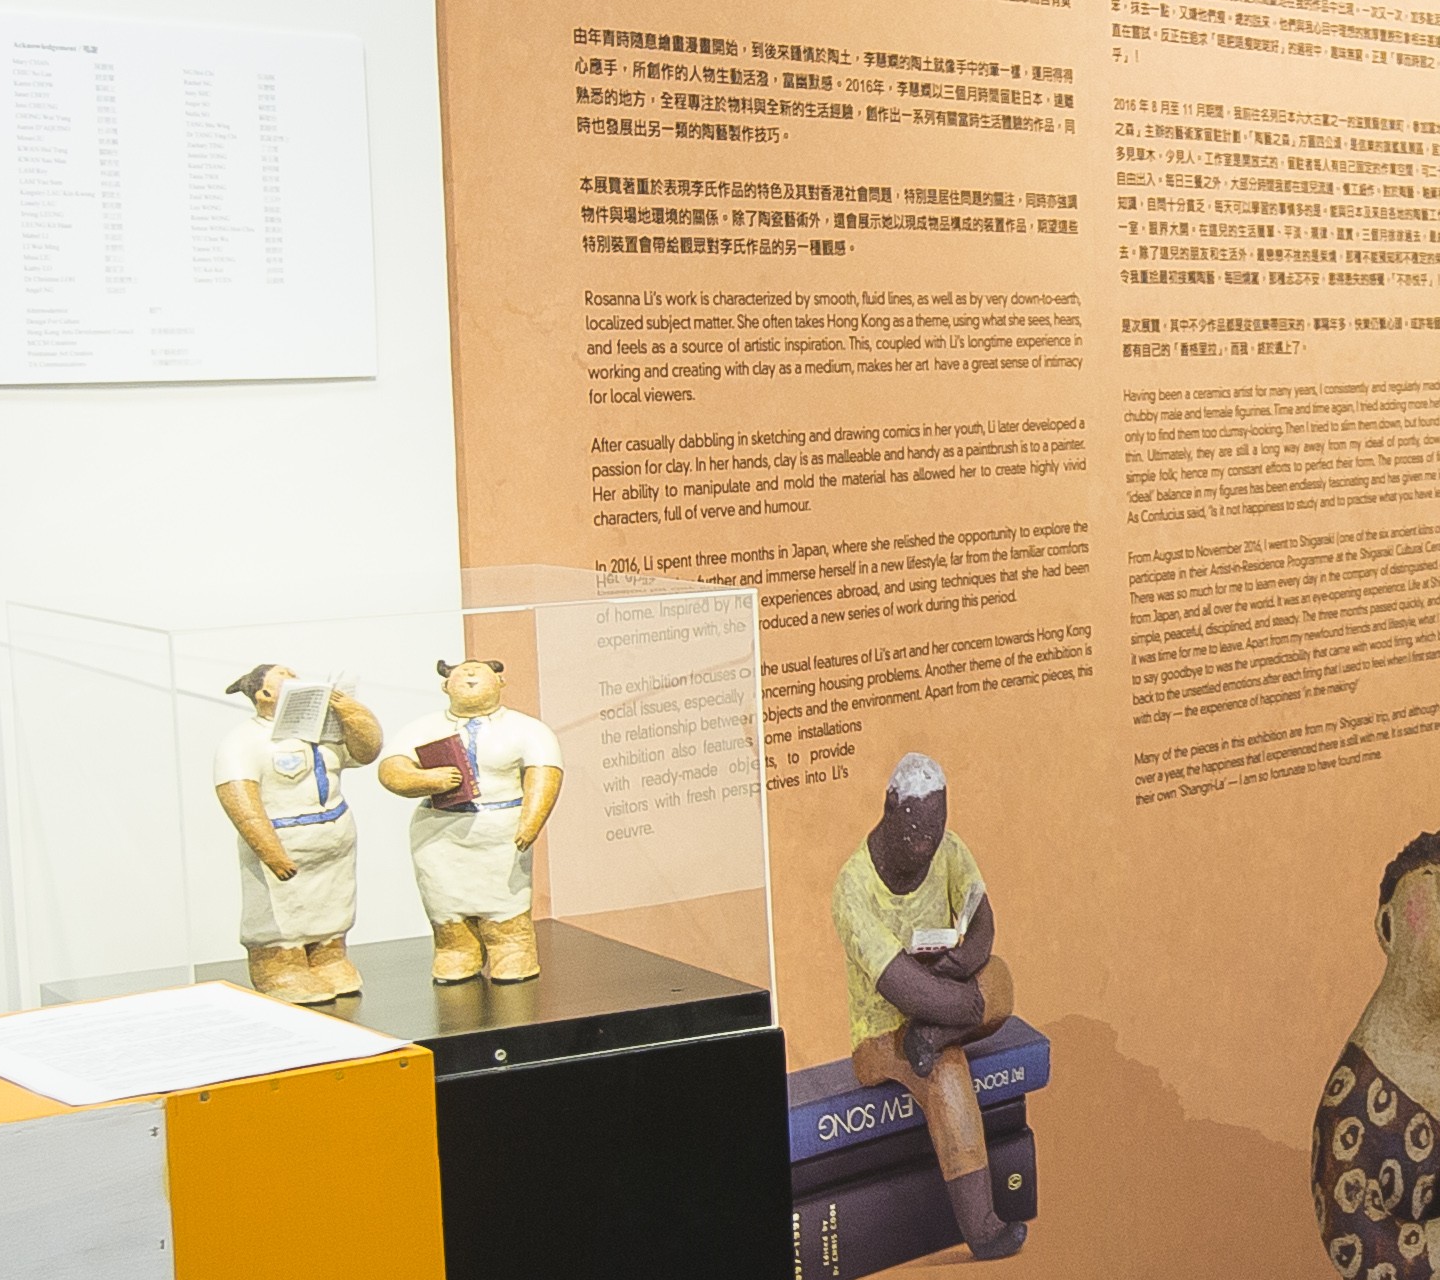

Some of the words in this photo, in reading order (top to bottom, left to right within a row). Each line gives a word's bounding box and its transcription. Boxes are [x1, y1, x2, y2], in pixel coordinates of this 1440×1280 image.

[585, 290, 640, 306] Rosanna
[644, 291, 662, 305] Li's
[666, 291, 697, 305] work
[701, 291, 709, 305] is
[713, 291, 792, 305] characterized
[795, 292, 810, 308] by
[814, 292, 859, 307] smooth,
[862, 291, 885, 305] fluid
[888, 292, 914, 306] lines,
[917, 295, 929, 305] as
[932, 292, 953, 305] well
[956, 295, 966, 305] as
[970, 292, 983, 307] by
[986, 295, 1007, 307] very
[587, 340, 612, 355] and
[617, 339, 647, 354] feels
[652, 343, 665, 354] as
[670, 343, 677, 353] a
[682, 342, 723, 353] source
[728, 338, 739, 352] of
[744, 338, 780, 352] artistic
[785, 337, 845, 354] inspiration.
[849, 336, 871, 351] This,
[876, 336, 921, 352] coupled
[925, 338, 946, 348] with
[950, 336, 964, 348] Li's
[1016, 337, 1071, 349] experience
[589, 389, 607, 404] for
[611, 388, 641, 403] local
[644, 388, 695, 402] viewers.
[591, 437, 622, 453] After
[626, 435, 675, 453] casually
[679, 433, 734, 450] dabbling
[738, 432, 748, 445] in
[752, 430, 805, 446] sketching
[809, 428, 831, 442] and
[834, 427, 879, 443] drawing
[883, 424, 920, 438] comics
[923, 424, 932, 436] in
[935, 423, 951, 435] her
[954, 422, 985, 438] youth,
[988, 421, 995, 433] Li
[998, 421, 1019, 432] later
[1022, 418, 1076, 431] developed
[1079, 420, 1085, 429] a
[594, 511, 661, 526] characters,
[664, 506, 682, 521] full
[685, 505, 697, 519] of
[701, 506, 735, 518] verve
[738, 501, 761, 516] and
[765, 500, 811, 513] humour.
[596, 560, 606, 571] In
[611, 557, 640, 573] 2016,
[644, 556, 653, 570] Li
[657, 555, 691, 569] spent
[696, 552, 727, 566] three
[880, 1093, 916, 1124] EW
[818, 1103, 876, 1141] SONG
